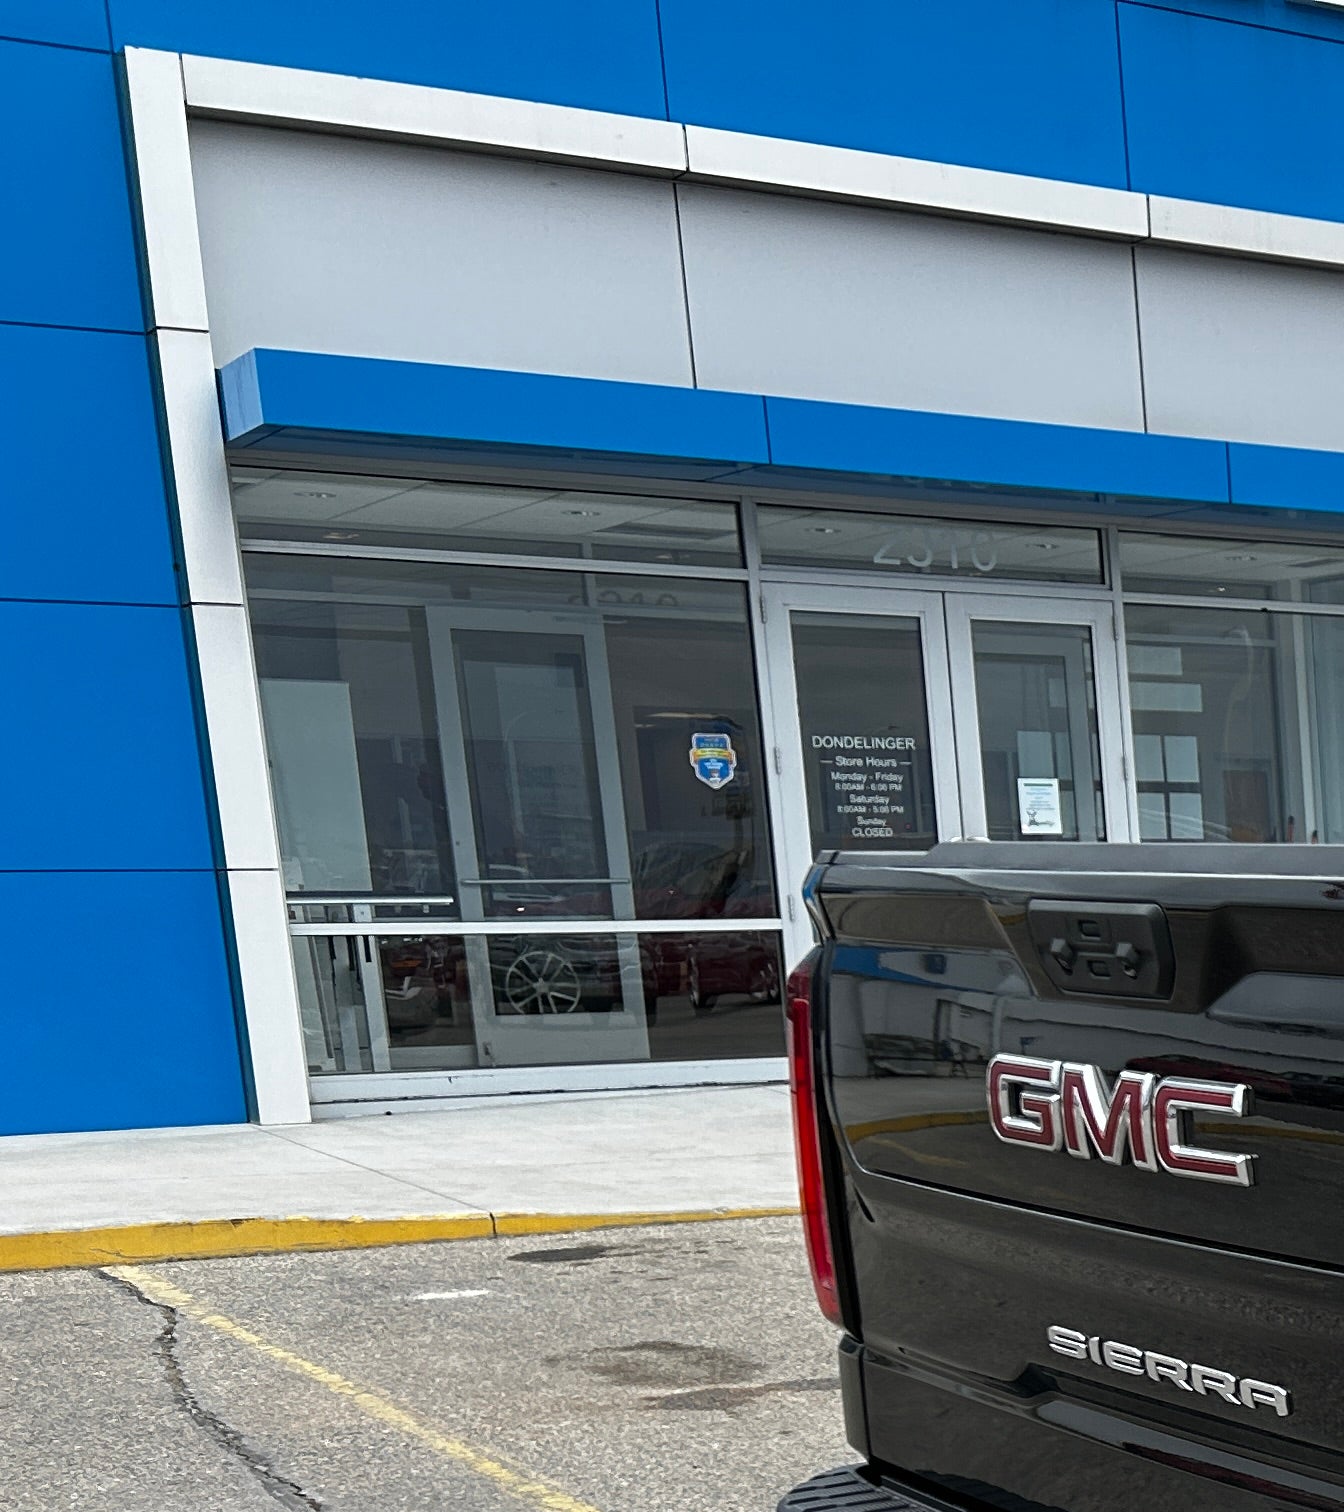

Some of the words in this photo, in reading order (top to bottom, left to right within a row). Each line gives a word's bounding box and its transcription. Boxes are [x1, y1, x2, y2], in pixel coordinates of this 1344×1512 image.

[811, 735, 917, 751] DONDELINGER
[835, 755, 864, 767] Store
[865, 756, 898, 768] Hours
[830, 771, 867, 783] Monday
[875, 771, 904, 783] Friday
[889, 783, 903, 791] PM
[849, 793, 890, 805] Saturday
[891, 805, 904, 814] PM
[856, 815, 887, 827] Sunday
[851, 827, 894, 838] CLOSED
[986, 1053, 1255, 1187] GMC
[1046, 1325, 1290, 1417] SIERRA
